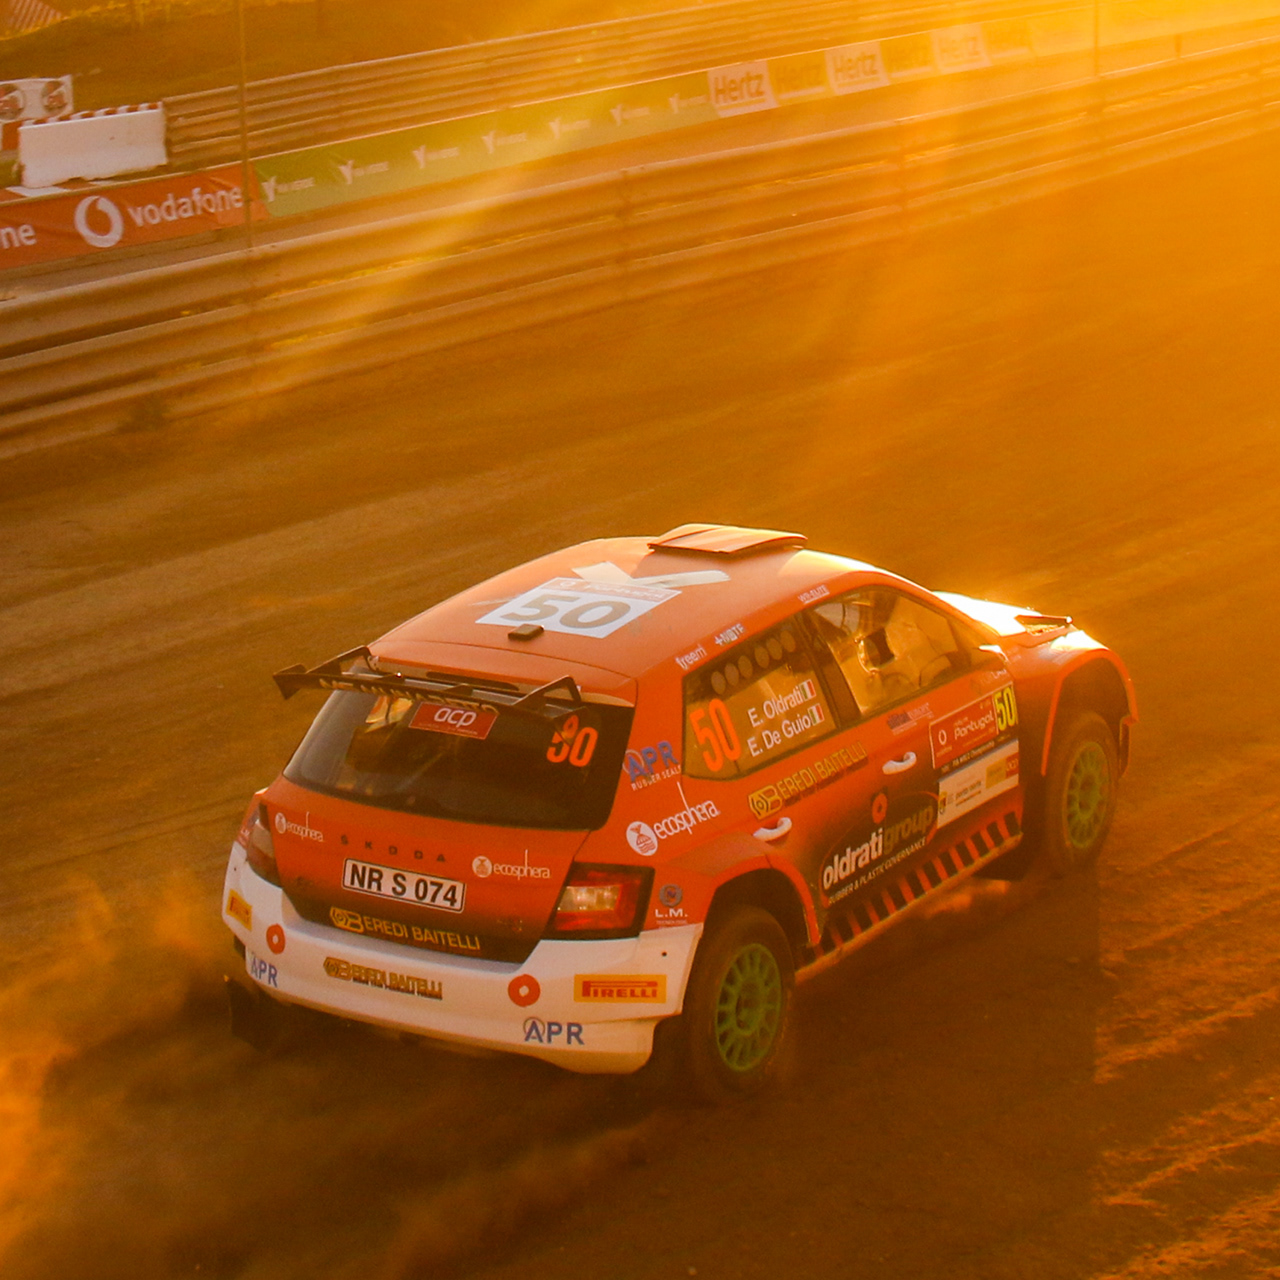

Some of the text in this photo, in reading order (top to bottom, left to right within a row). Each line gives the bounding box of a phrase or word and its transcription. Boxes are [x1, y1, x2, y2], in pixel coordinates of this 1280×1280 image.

[832, 51, 878, 81] Hertz
[713, 71, 765, 105] Hertz
[128, 184, 244, 228] vodafone
[499, 592, 632, 631] 50
[433, 706, 477, 729] acp
[747, 685, 802, 728] E. Oldrati
[994, 686, 1016, 732] 50
[688, 698, 741, 772] 50
[747, 714, 812, 757] E. De Guio
[627, 740, 679, 783] APR
[777, 766, 816, 801] EREDI
[287, 811, 325, 842] ecosphera
[653, 781, 721, 839] ecosphera
[491, 849, 551, 881] ecosphera
[349, 864, 458, 907] NR S 074
[654, 907, 689, 919] L.M.
[363, 916, 482, 951] EREDI BAITELLI
[250, 958, 278, 988] APR
[352, 964, 443, 1000] EREDI BAITELLI
[582, 980, 658, 999] PIRELLI
[524, 1017, 585, 1046] APR
